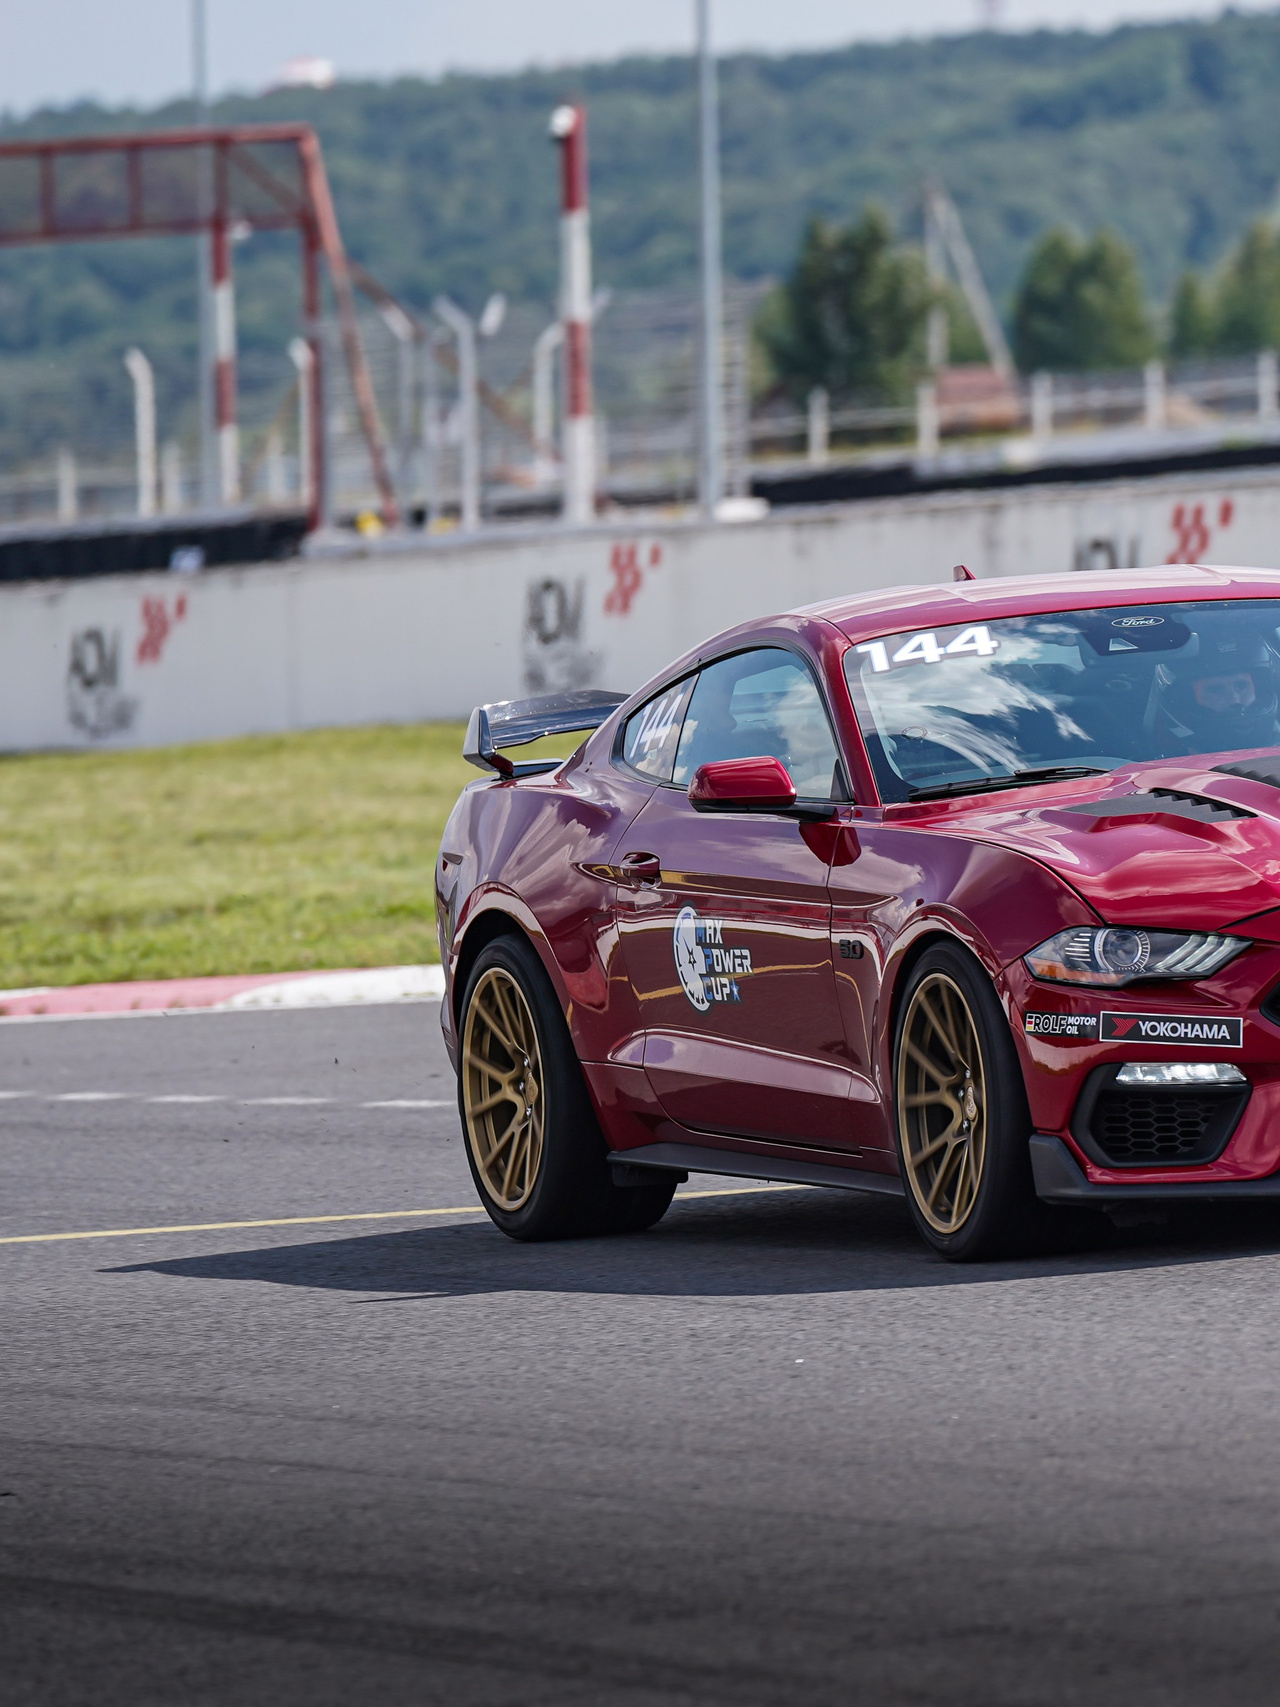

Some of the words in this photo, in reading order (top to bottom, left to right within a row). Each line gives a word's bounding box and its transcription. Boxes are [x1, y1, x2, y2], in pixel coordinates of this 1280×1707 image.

[1121, 617, 1156, 627] Ford
[857, 626, 998, 671] 144
[630, 693, 684, 758] 144
[696, 920, 723, 944] MAX
[705, 948, 752, 974] POWER
[702, 977, 731, 1001] CUP
[1033, 1014, 1068, 1034] ROLF
[1066, 1027, 1079, 1035] OIL
[1067, 1016, 1097, 1026] MOTOR
[1139, 1021, 1231, 1040] YOKOHAMA
